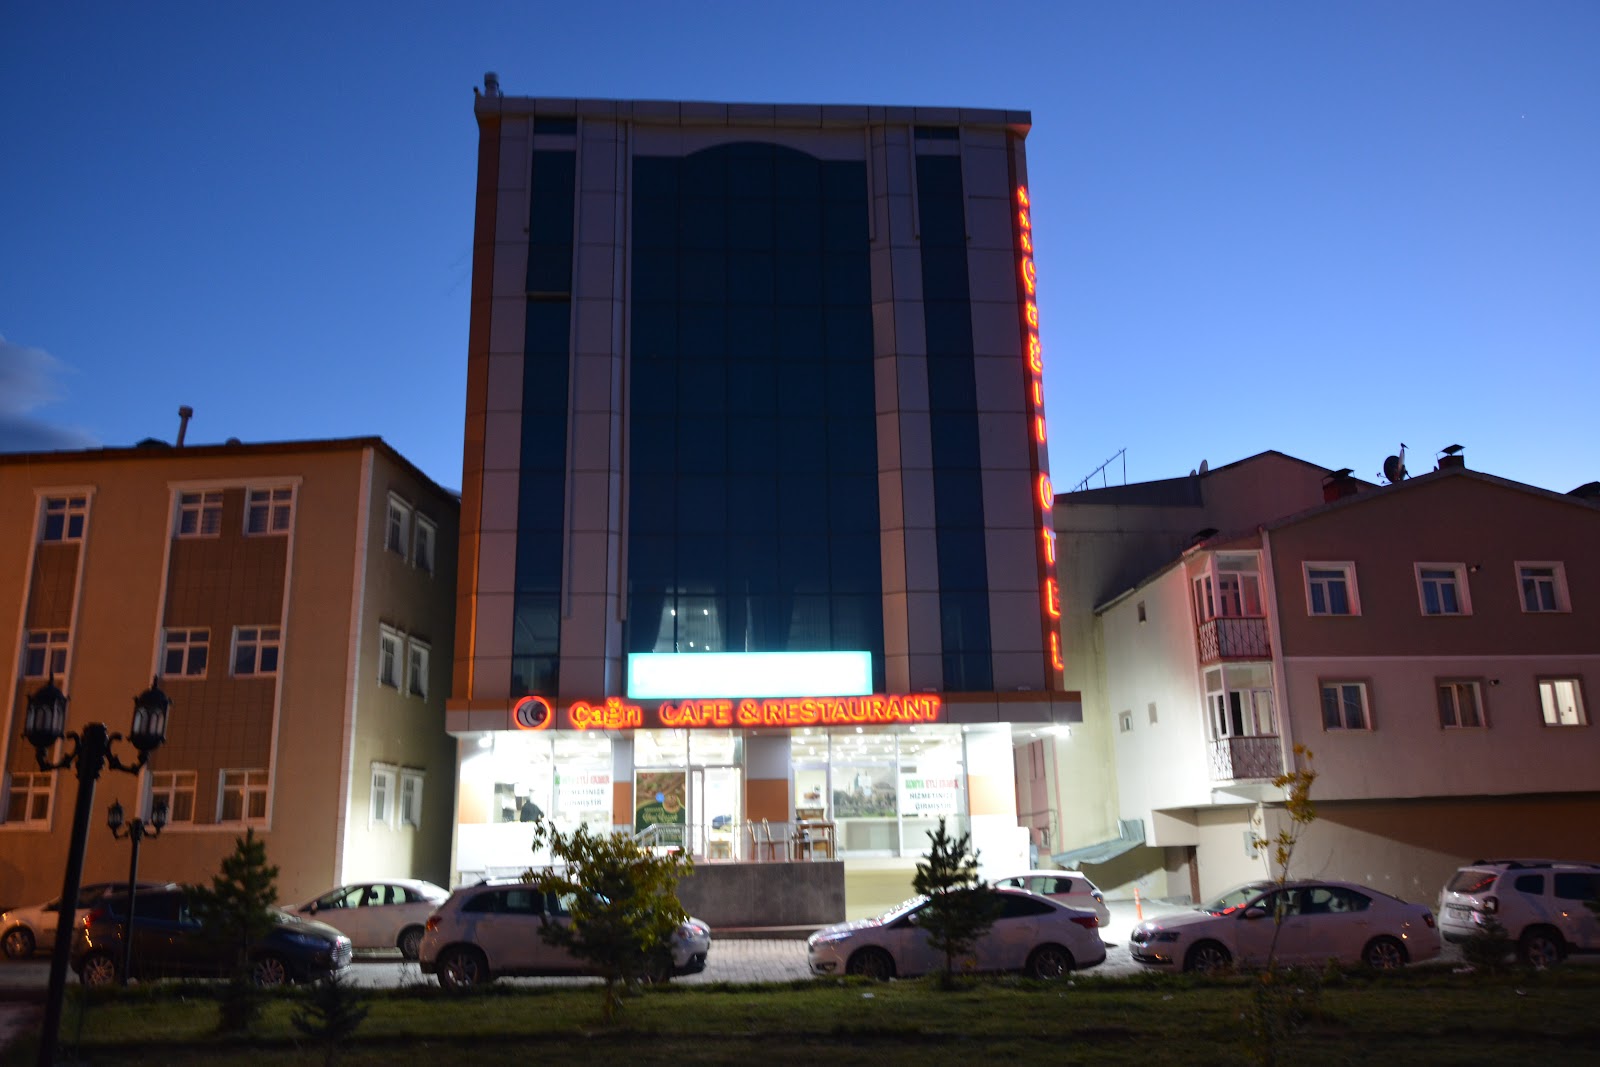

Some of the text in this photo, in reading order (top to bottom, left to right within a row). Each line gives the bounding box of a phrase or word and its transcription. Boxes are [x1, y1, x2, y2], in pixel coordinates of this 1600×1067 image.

[1037, 473, 1065, 672] OTEL
[659, 698, 733, 726] CAFE
[737, 697, 763, 725] &
[763, 694, 941, 724] RESTAURANT
